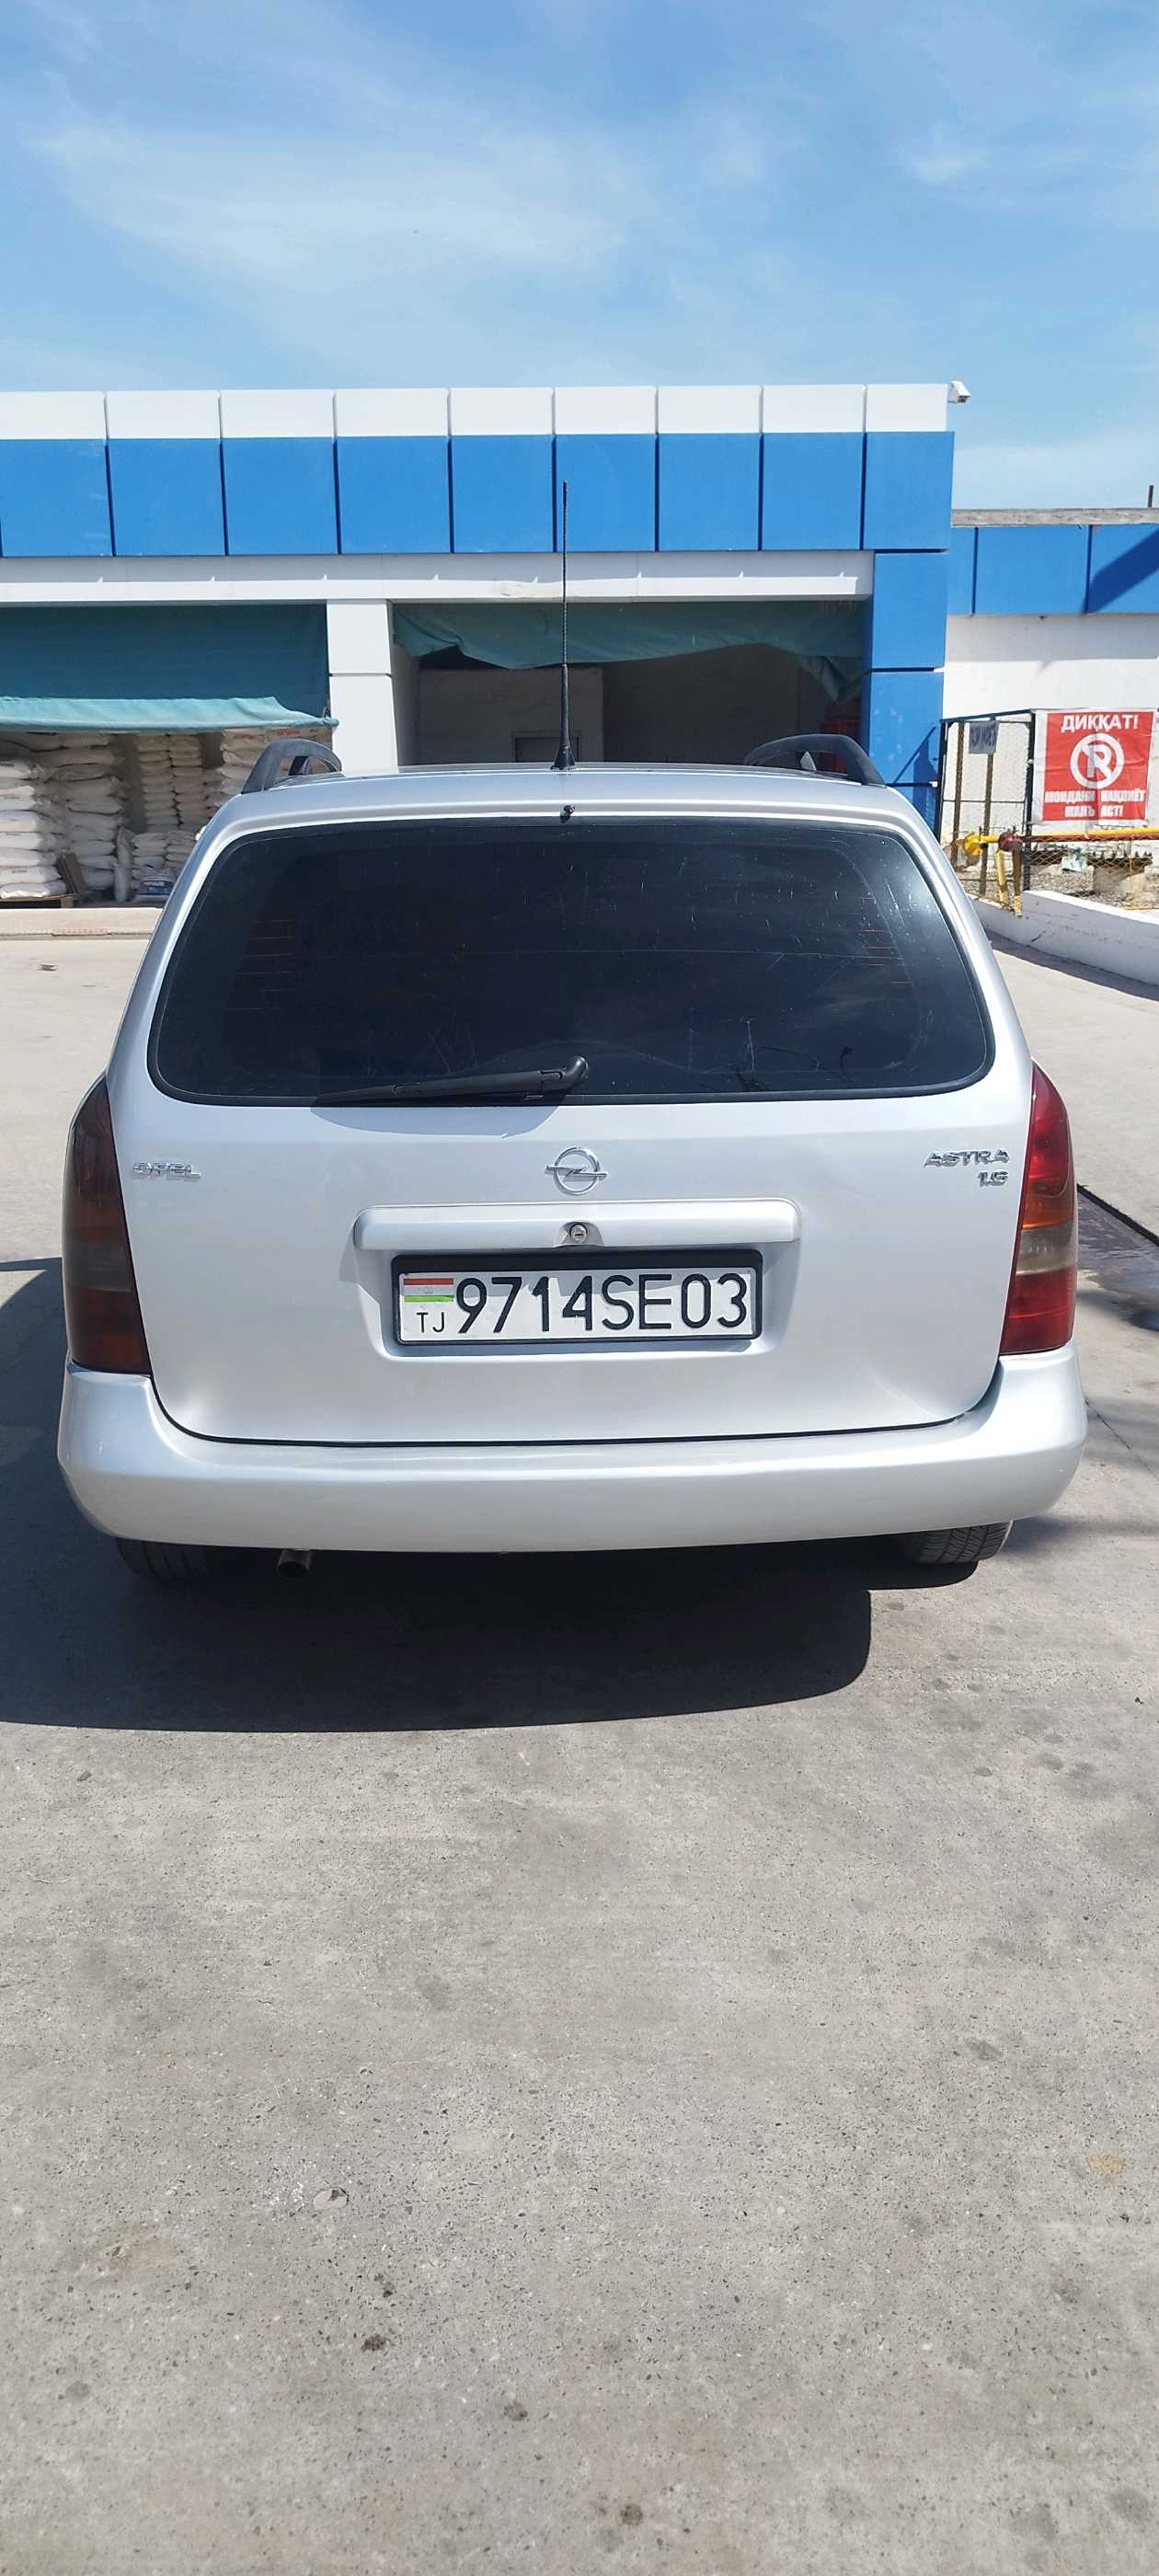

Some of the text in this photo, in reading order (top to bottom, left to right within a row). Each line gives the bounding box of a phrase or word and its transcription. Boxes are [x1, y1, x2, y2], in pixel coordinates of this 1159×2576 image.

[1061, 714, 1139, 733] ДИҚҚАТ!
[923, 1148, 1010, 1168] ASTRA
[456, 1272, 748, 1334] 9714SE03
[416, 1311, 445, 1334] TJ
